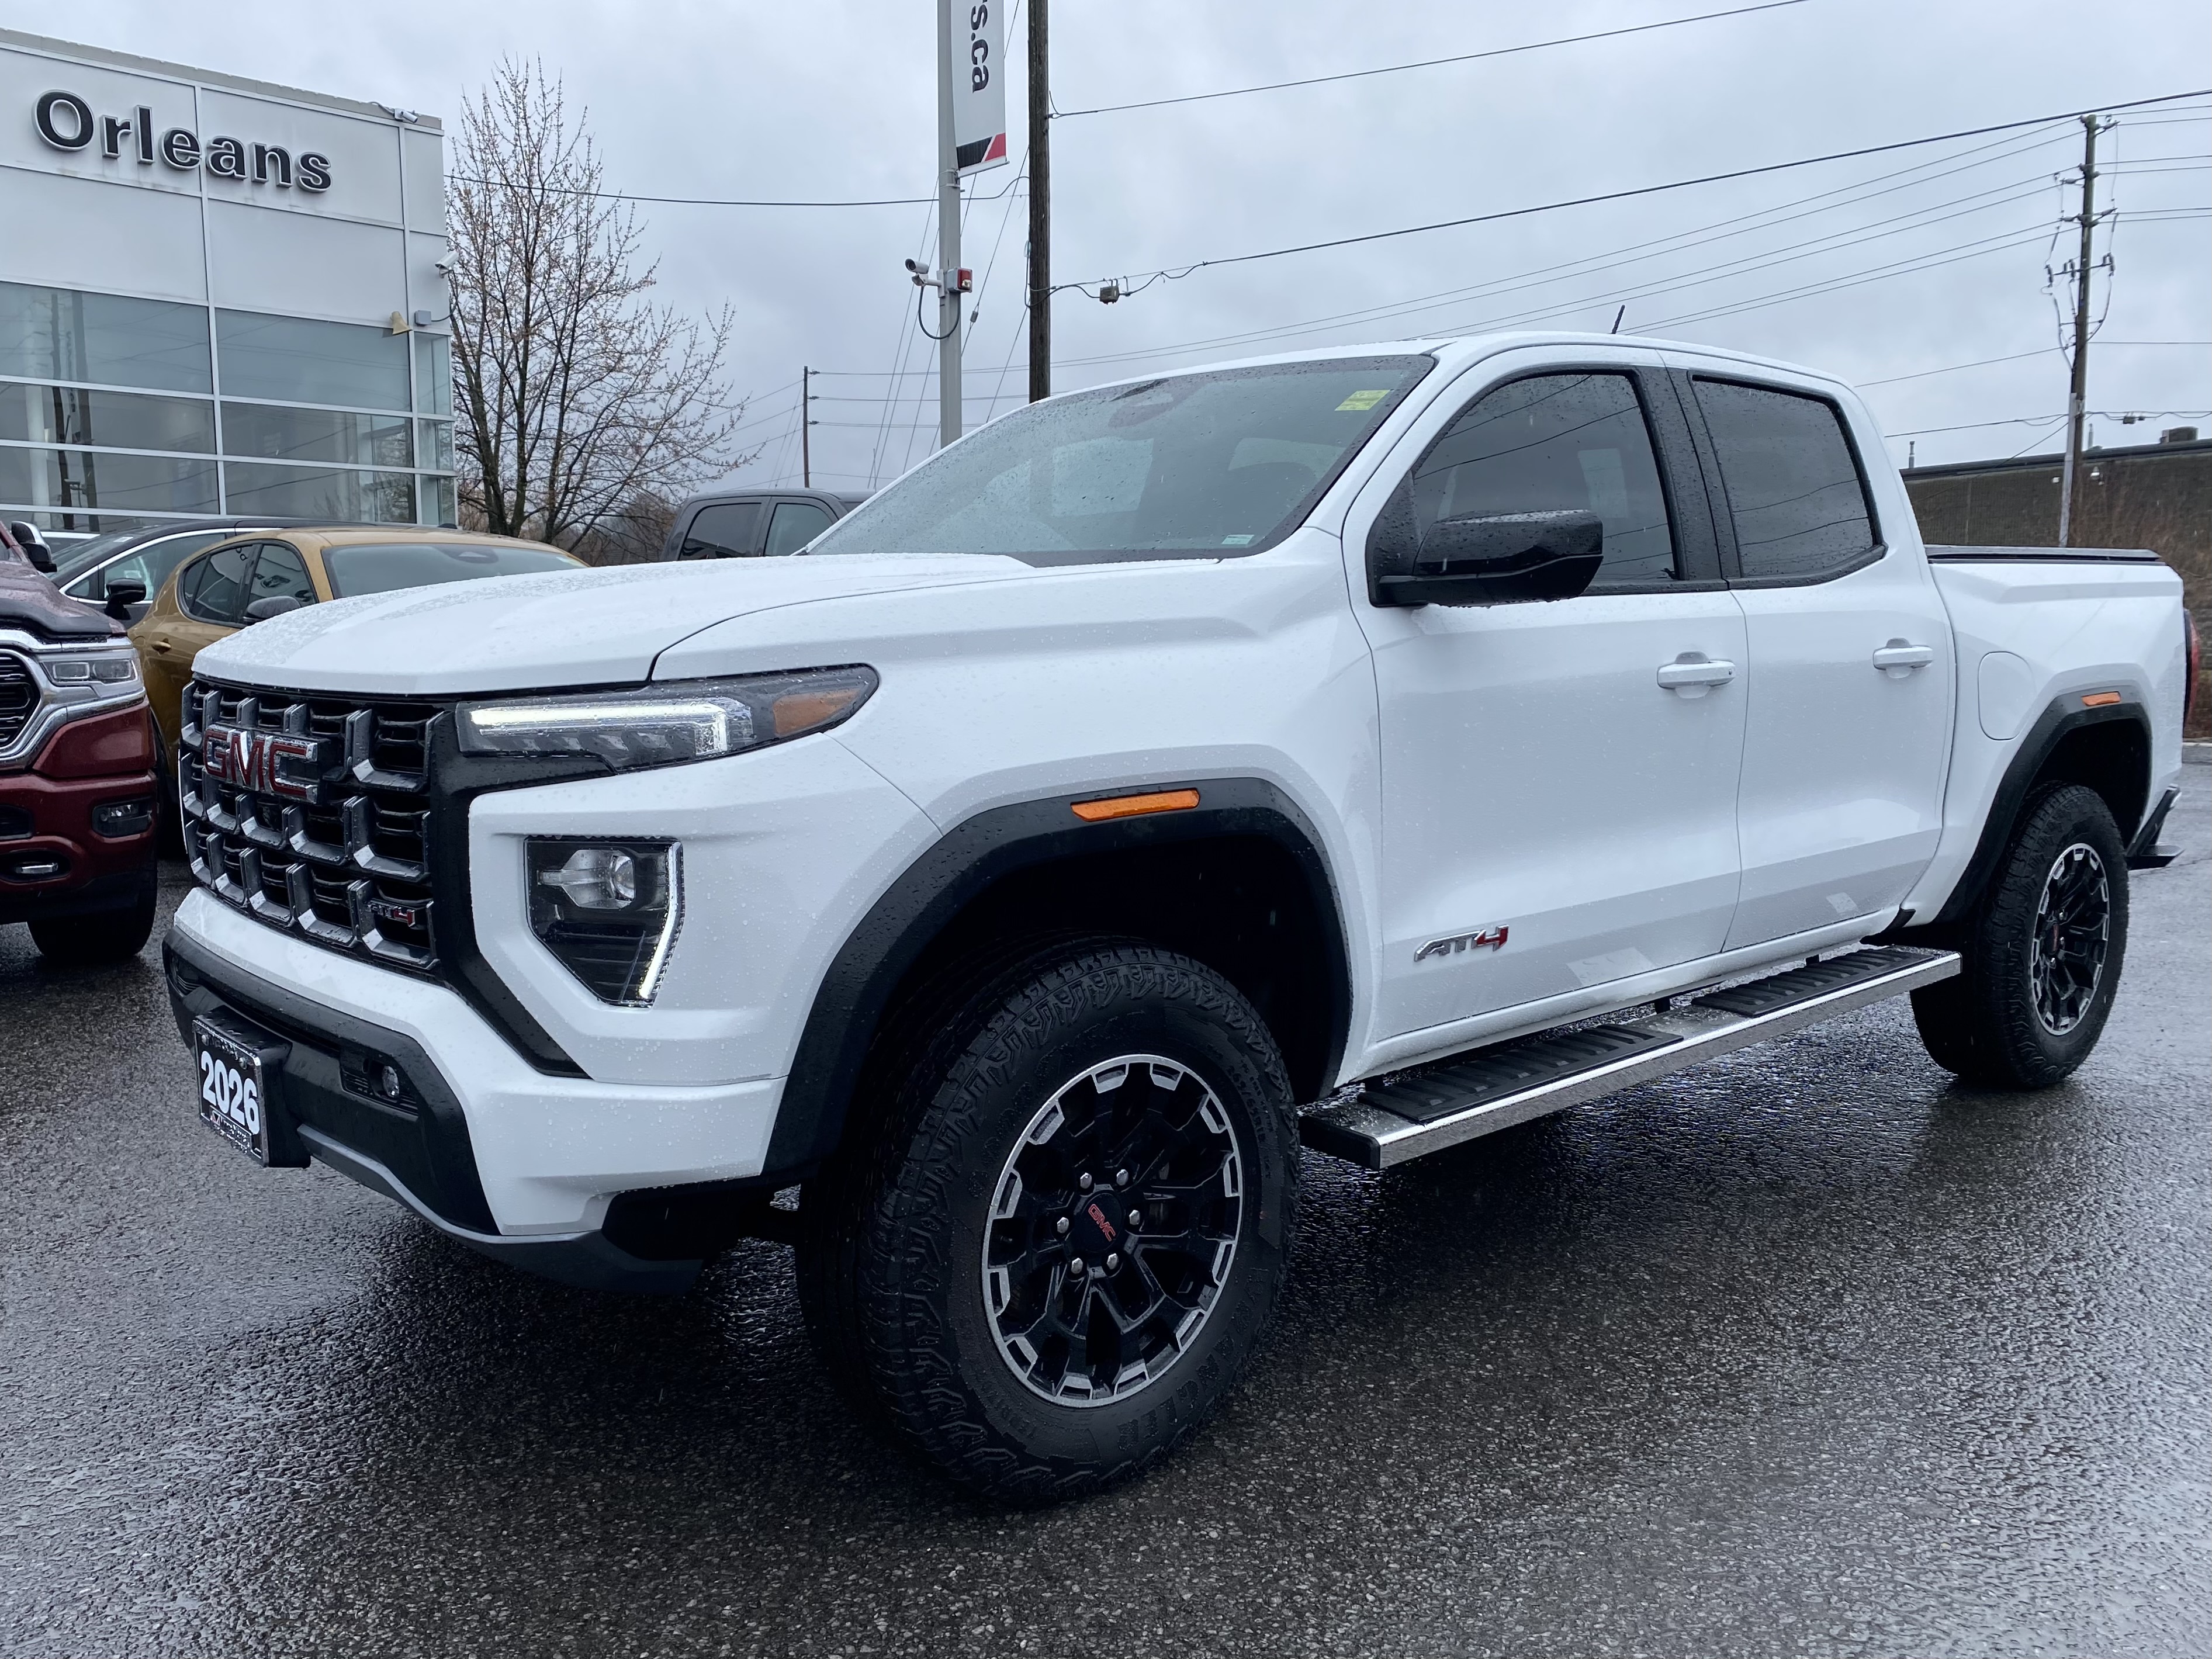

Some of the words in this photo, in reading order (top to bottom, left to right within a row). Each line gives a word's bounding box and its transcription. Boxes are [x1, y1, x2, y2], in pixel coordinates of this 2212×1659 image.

[971, 0, 989, 93] s.ca
[33, 89, 332, 192] Orleans
[203, 723, 318, 804] GMC
[1414, 924, 1509, 962] AT4
[200, 1051, 261, 1135] 2026
[1088, 1203, 1116, 1242] GMC
